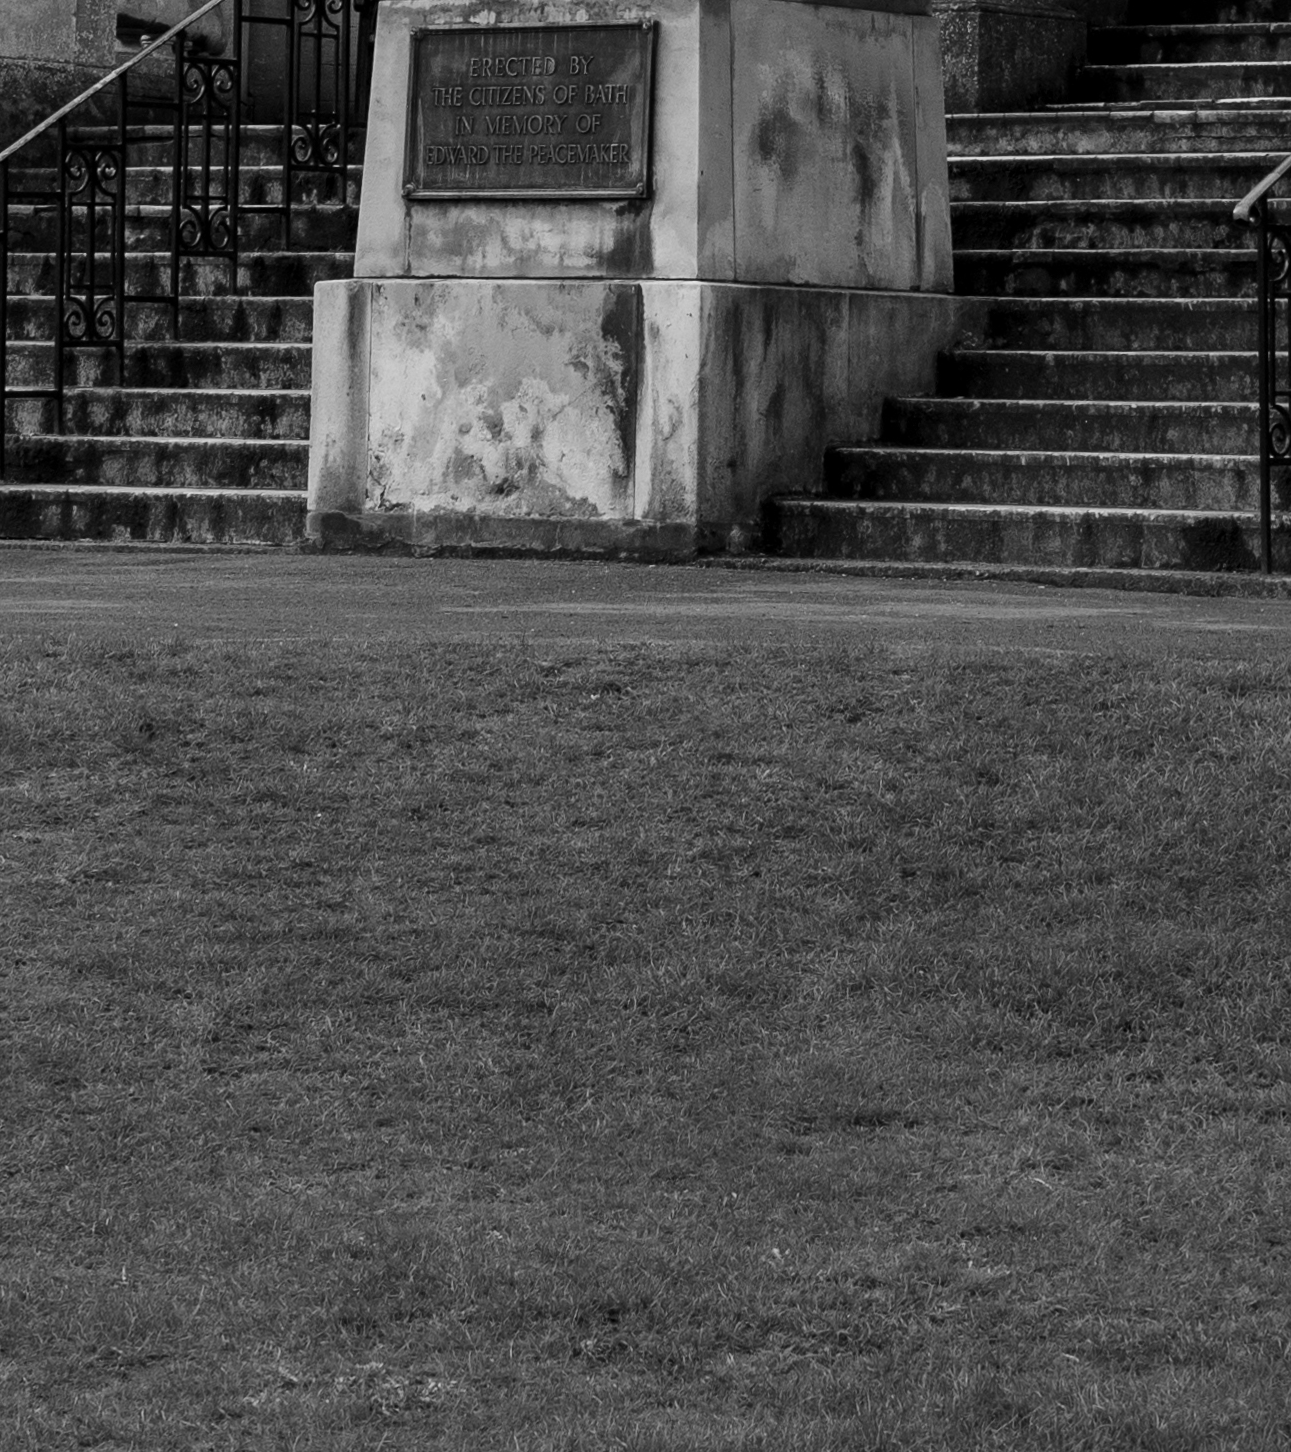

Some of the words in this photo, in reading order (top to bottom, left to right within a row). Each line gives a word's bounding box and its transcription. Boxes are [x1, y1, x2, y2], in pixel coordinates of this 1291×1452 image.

[469, 56, 556, 77] ERECTED
[569, 55, 594, 76] BY
[431, 86, 463, 107] THE
[468, 85, 546, 107] CITIZENS
[553, 84, 579, 105] OF
[584, 83, 629, 105] BATH
[454, 115, 475, 136] IN
[485, 114, 568, 135] MEMORY
[575, 113, 603, 134] OF
[426, 145, 490, 166] EDWARD
[493, 144, 524, 165] THE
[528, 143, 631, 165] PEACEMAKER
